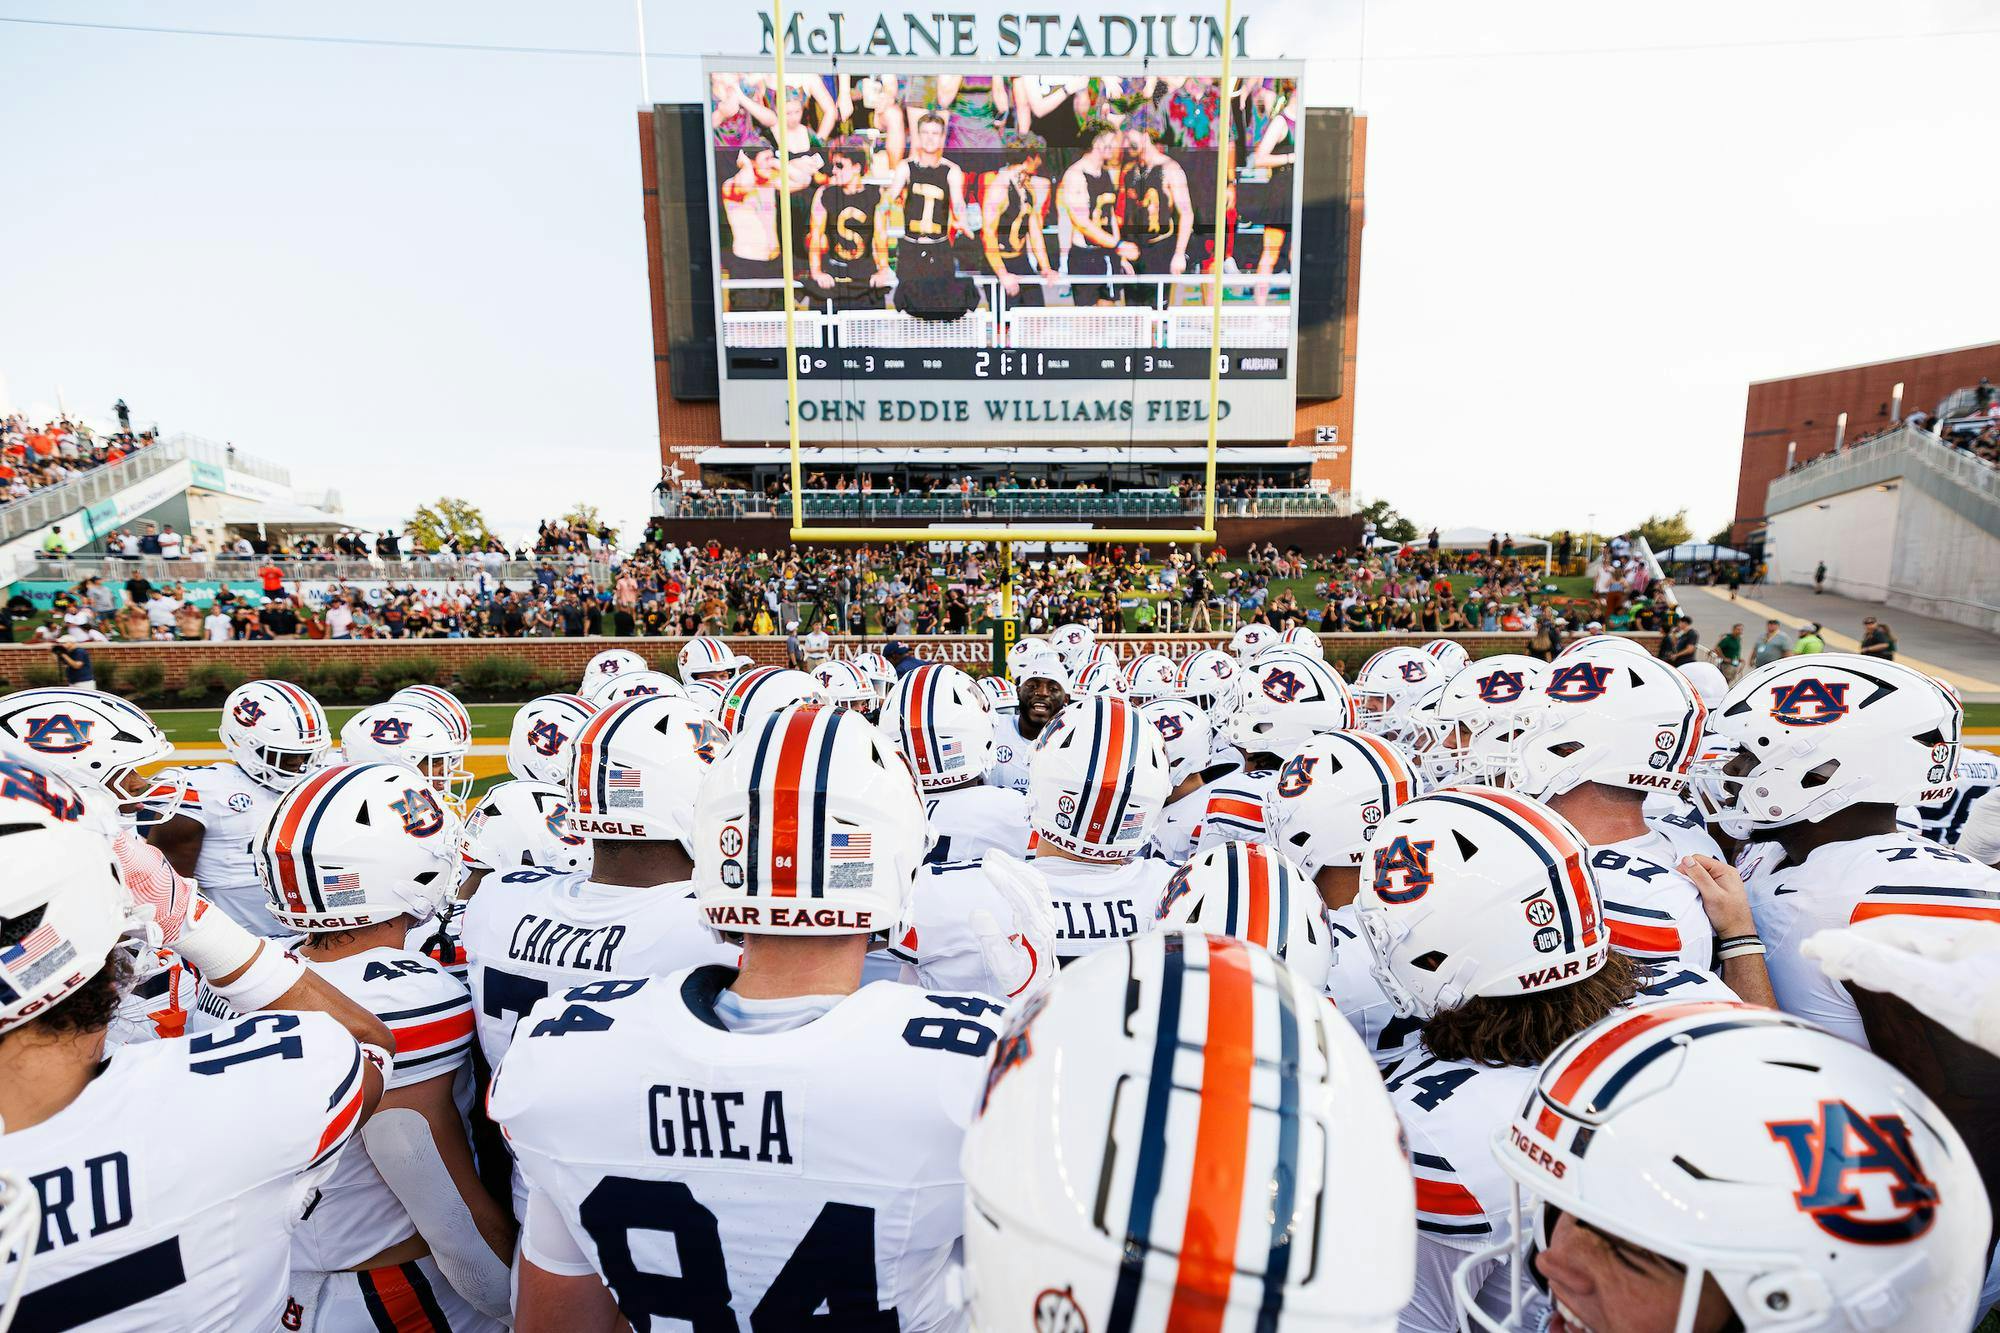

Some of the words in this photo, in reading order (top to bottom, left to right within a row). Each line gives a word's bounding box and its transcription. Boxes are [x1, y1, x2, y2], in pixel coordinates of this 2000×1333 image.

[758, 11, 979, 56] McLANE
[997, 14, 1249, 58] STADIUM
[1240, 357, 1280, 371] AUBURN
[878, 400, 970, 421] EDDIE
[984, 399, 1133, 422] WILLIAMS
[1146, 400, 1232, 422] FIELD
[1262, 667, 1306, 704] AU
[1476, 670, 1526, 704] AU
[1544, 662, 1615, 704] AU
[233, 697, 268, 729] AU
[1769, 678, 1851, 727] AU
[24, 714, 95, 754] AU
[370, 716, 413, 745] AU
[527, 718, 569, 757] AU
[921, 774, 969, 787] EAGLE
[1277, 754, 1320, 799] AU
[1628, 774, 1671, 789] WAR
[1920, 786, 1954, 801] WAR
[388, 787, 445, 839] AU
[579, 819, 647, 838] EAGLE
[721, 827, 742, 856] SEC
[1041, 827, 1077, 852] WAR
[1080, 846, 1136, 859] EAGLE
[775, 856, 793, 869] 84
[1373, 834, 1436, 905] AU
[1592, 849, 1670, 884] 87
[293, 915, 373, 929] EAGLE
[705, 906, 761, 926] WAR
[769, 907, 872, 929] EAGLE
[1528, 902, 1553, 925] SEC
[1585, 914, 1593, 926] 14
[508, 914, 627, 973] CARTER
[1537, 932, 1559, 950] BCW
[1518, 960, 1580, 991] WAR
[902, 995, 1006, 1058] 84
[189, 1013, 304, 1076] 15
[648, 1084, 793, 1165] GHEA
[1512, 1125, 1567, 1180] TIGERS
[1764, 1099, 1942, 1246] AU
[7, 1150, 133, 1264] RD
[579, 1174, 902, 1333] 84
